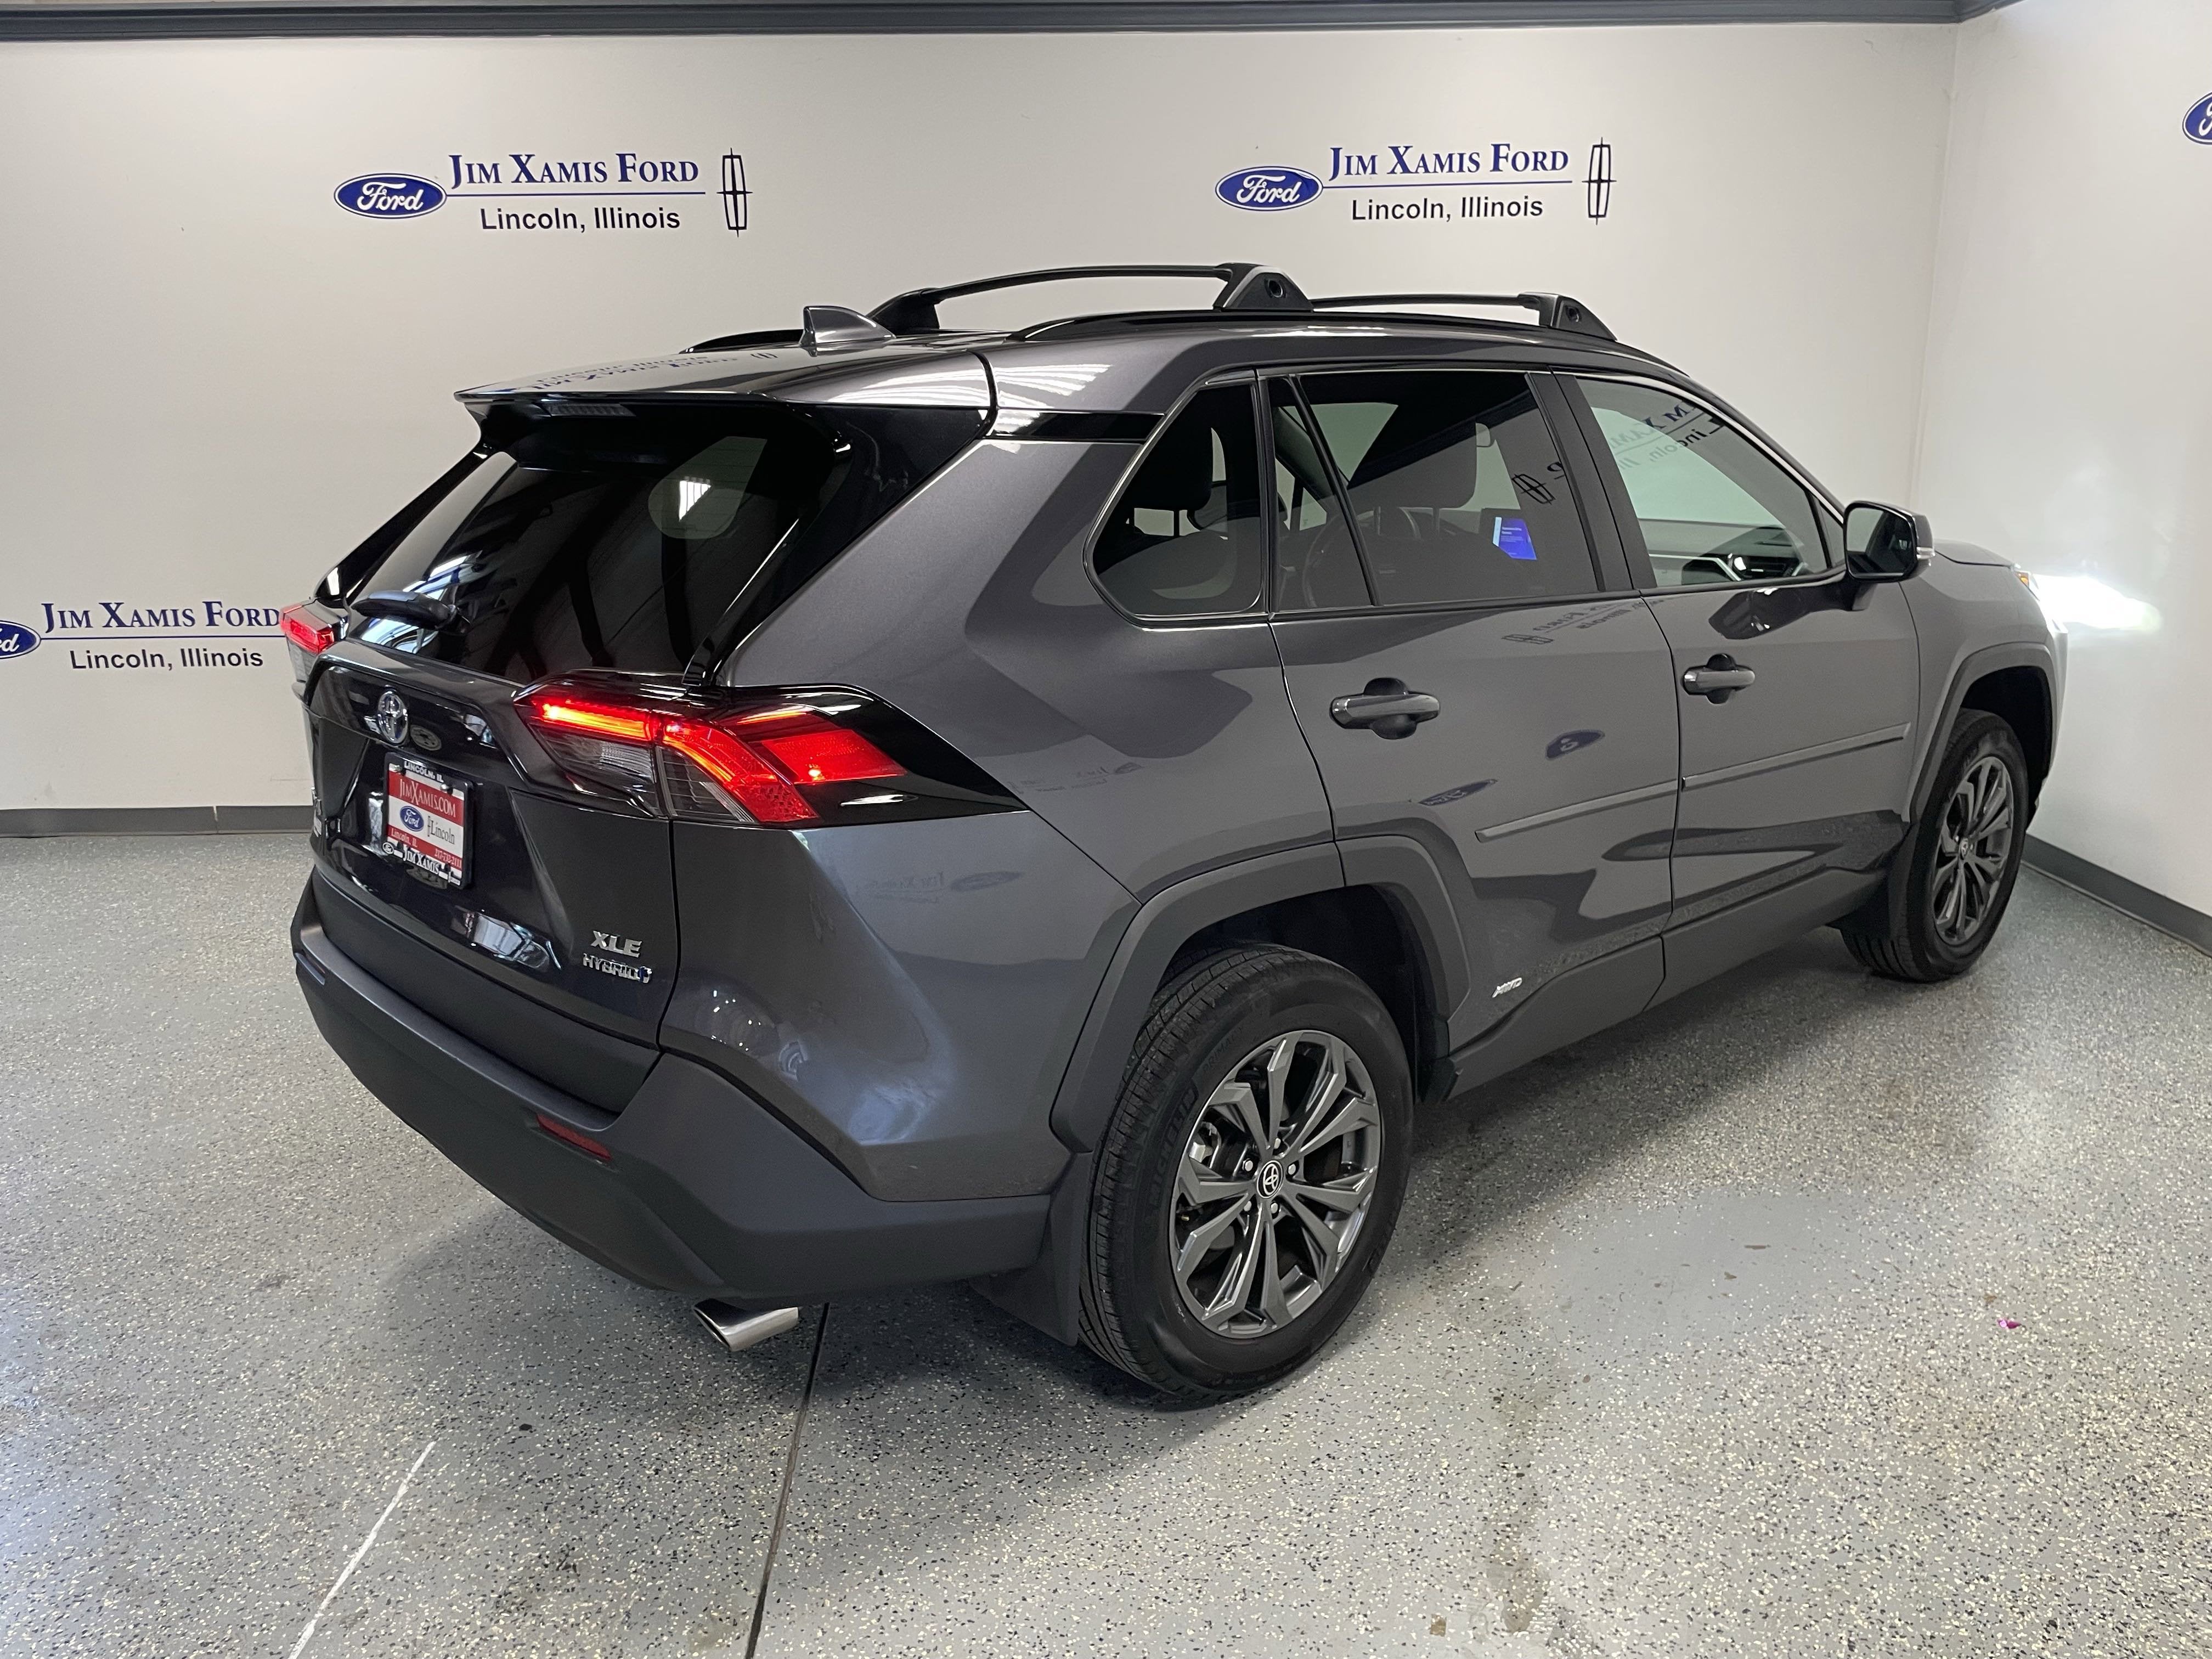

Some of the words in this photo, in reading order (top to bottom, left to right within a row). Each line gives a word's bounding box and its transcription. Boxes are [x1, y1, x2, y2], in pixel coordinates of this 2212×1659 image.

[448, 155, 503, 190] JIM
[508, 154, 608, 184] XAMIS
[615, 153, 699, 183] FORD
[1329, 147, 1378, 182] JIM
[1386, 145, 1481, 174] XAMIS
[1489, 143, 1568, 172] FORD
[481, 207, 585, 233] Lincoln,
[594, 207, 681, 229] Illinois
[1352, 198, 1451, 222] Lincoln,
[1461, 195, 1543, 218] Illinois
[41, 603, 93, 634] JIM
[98, 601, 196, 628] XAMIS
[69, 648, 173, 671] Lincoln,
[180, 647, 264, 668] Illinois
[431, 820, 455, 845] Lincoln
[590, 930, 642, 958] XLE
[583, 952, 641, 982] HYBRID
